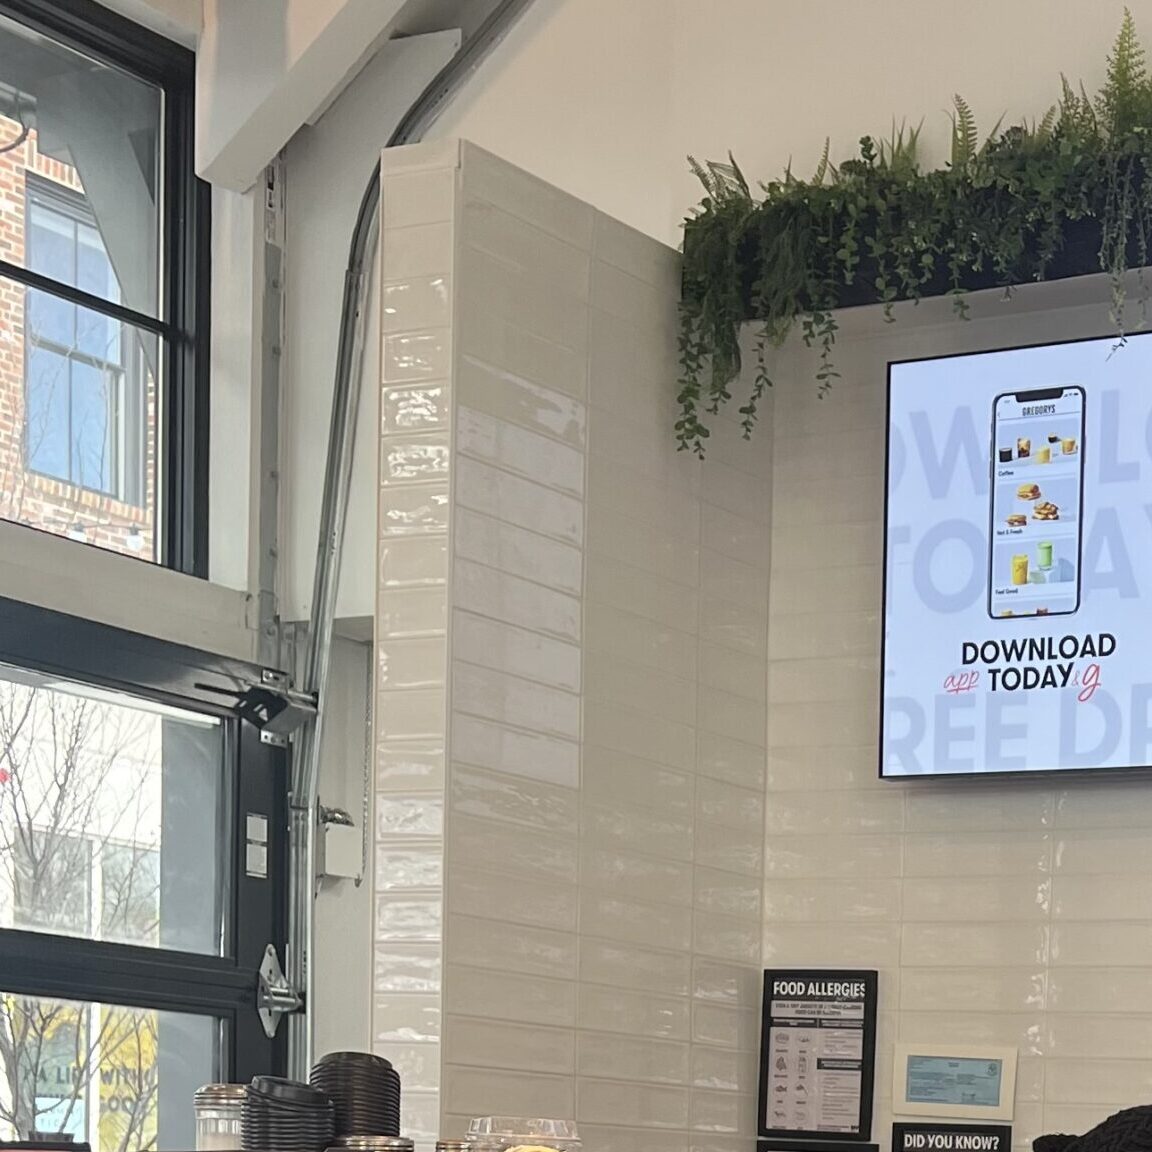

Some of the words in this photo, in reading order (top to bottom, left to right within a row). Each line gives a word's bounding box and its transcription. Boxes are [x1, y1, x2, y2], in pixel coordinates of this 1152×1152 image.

[1022, 404, 1056, 416] GREGORYS
[962, 633, 1116, 665] DOWNLOAD
[944, 669, 979, 694] app
[988, 662, 1075, 692] TODAY
[773, 981, 806, 995] FOOD
[807, 982, 865, 998] ALLERGIES
[904, 1133, 925, 1148] DID
[927, 1134, 953, 1149] YOU
[955, 1135, 1000, 1150] KNOW?
